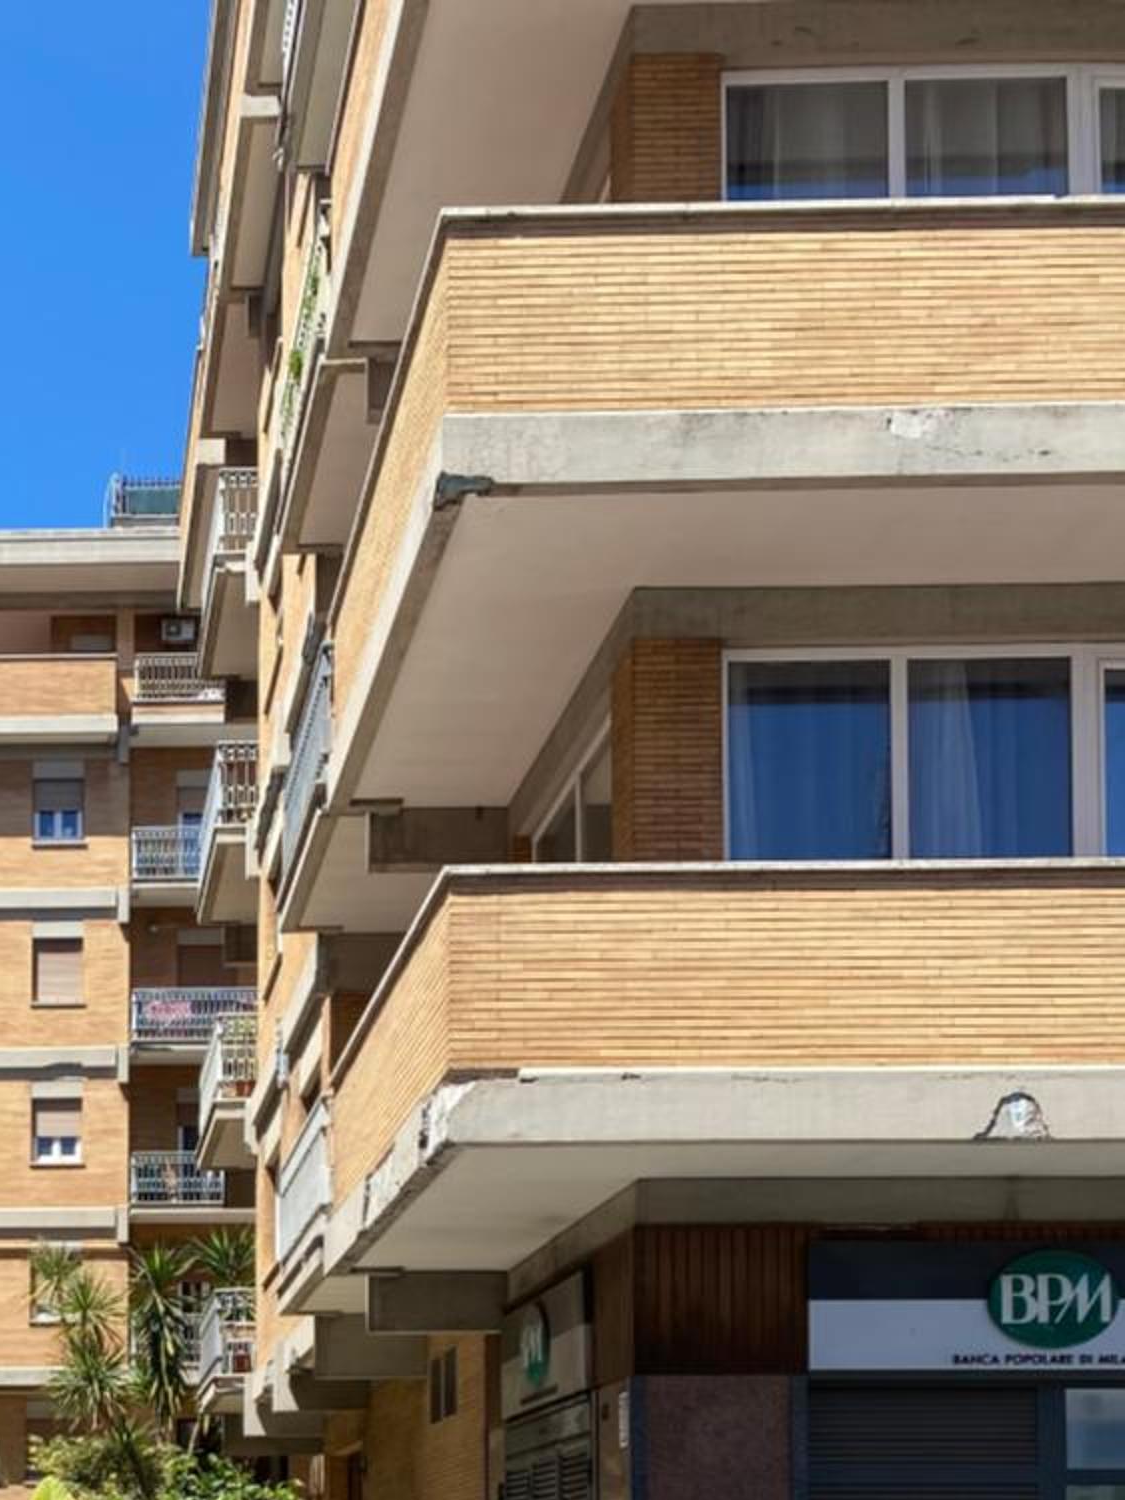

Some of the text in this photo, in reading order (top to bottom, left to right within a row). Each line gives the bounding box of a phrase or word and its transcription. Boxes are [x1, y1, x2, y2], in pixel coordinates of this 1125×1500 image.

[1000, 1273, 1111, 1325] BPM
[953, 1353, 1000, 1365] BANCA
[1005, 1353, 1074, 1365] POPOLARE
[1079, 1353, 1093, 1365] DI
